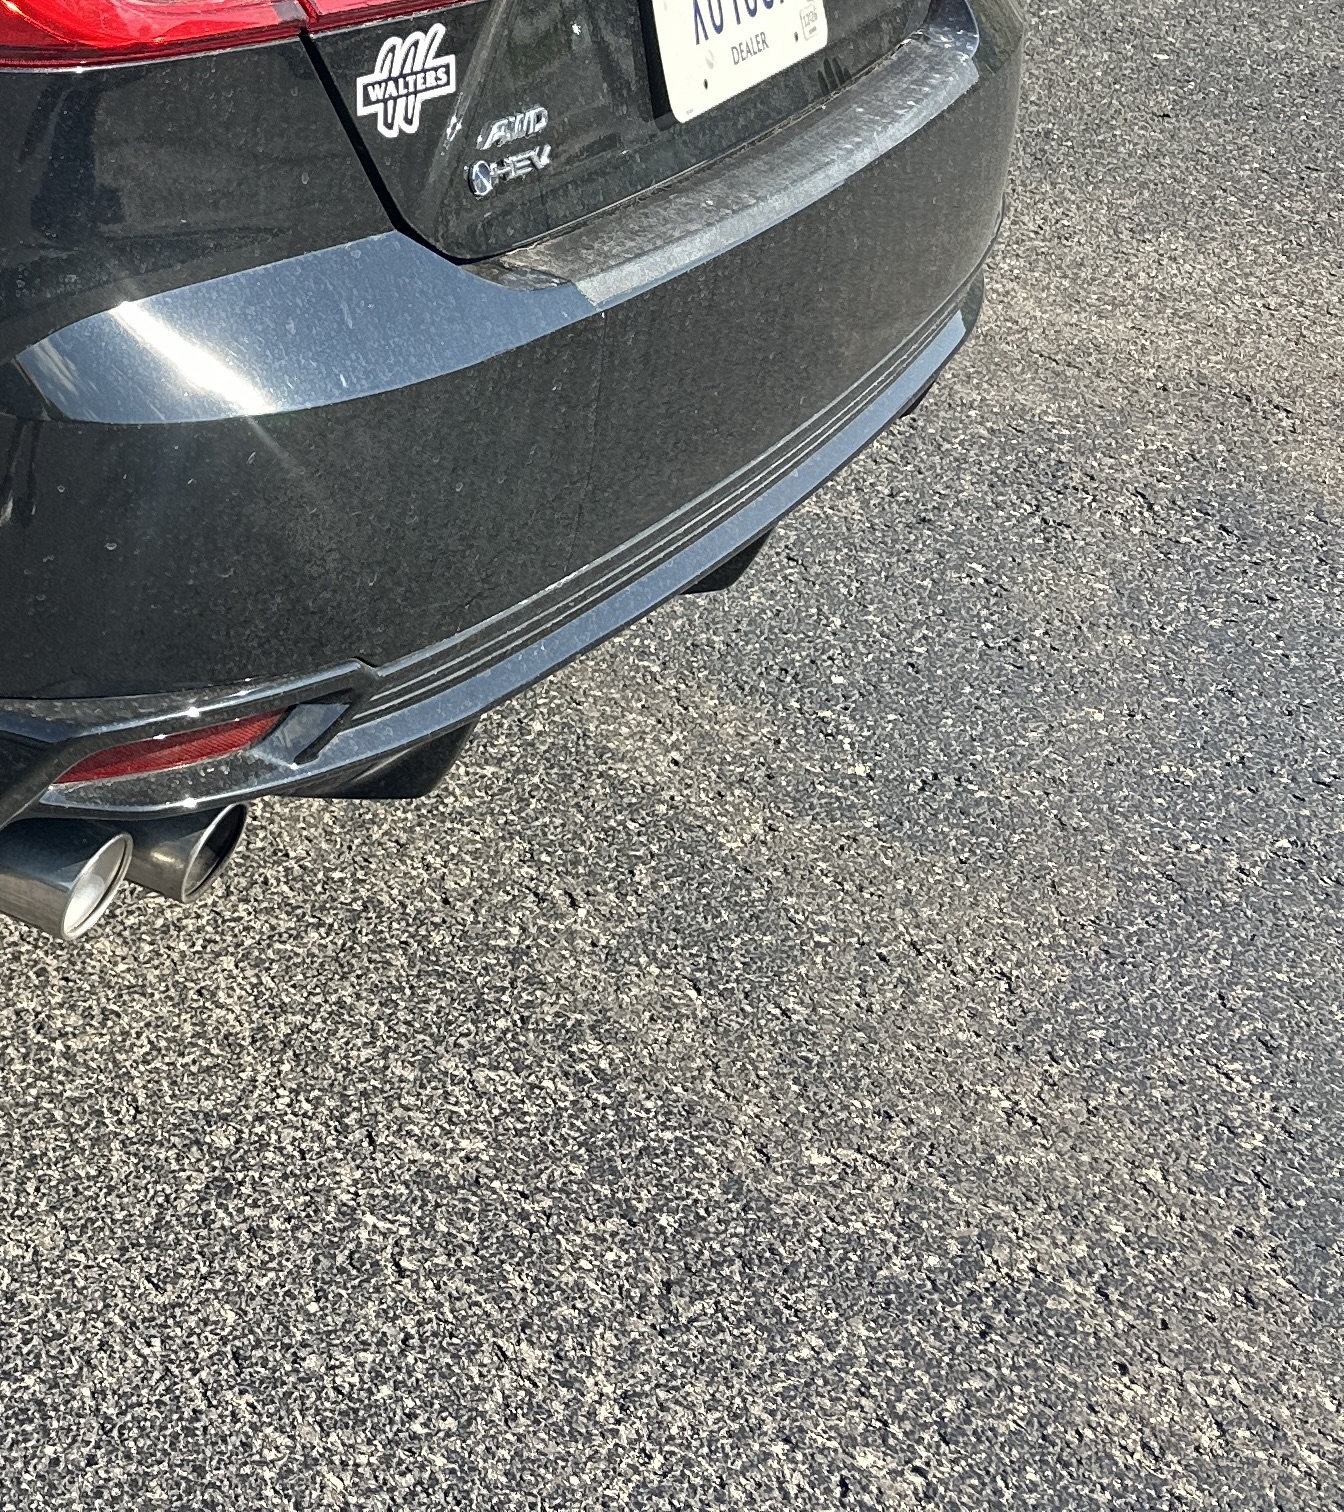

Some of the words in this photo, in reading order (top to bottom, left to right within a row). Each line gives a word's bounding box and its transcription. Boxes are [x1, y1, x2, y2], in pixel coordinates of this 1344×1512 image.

[731, 31, 769, 65] DEALER
[367, 68, 448, 102] WALTERS
[480, 107, 549, 150] AWD
[490, 144, 552, 183] HEV
